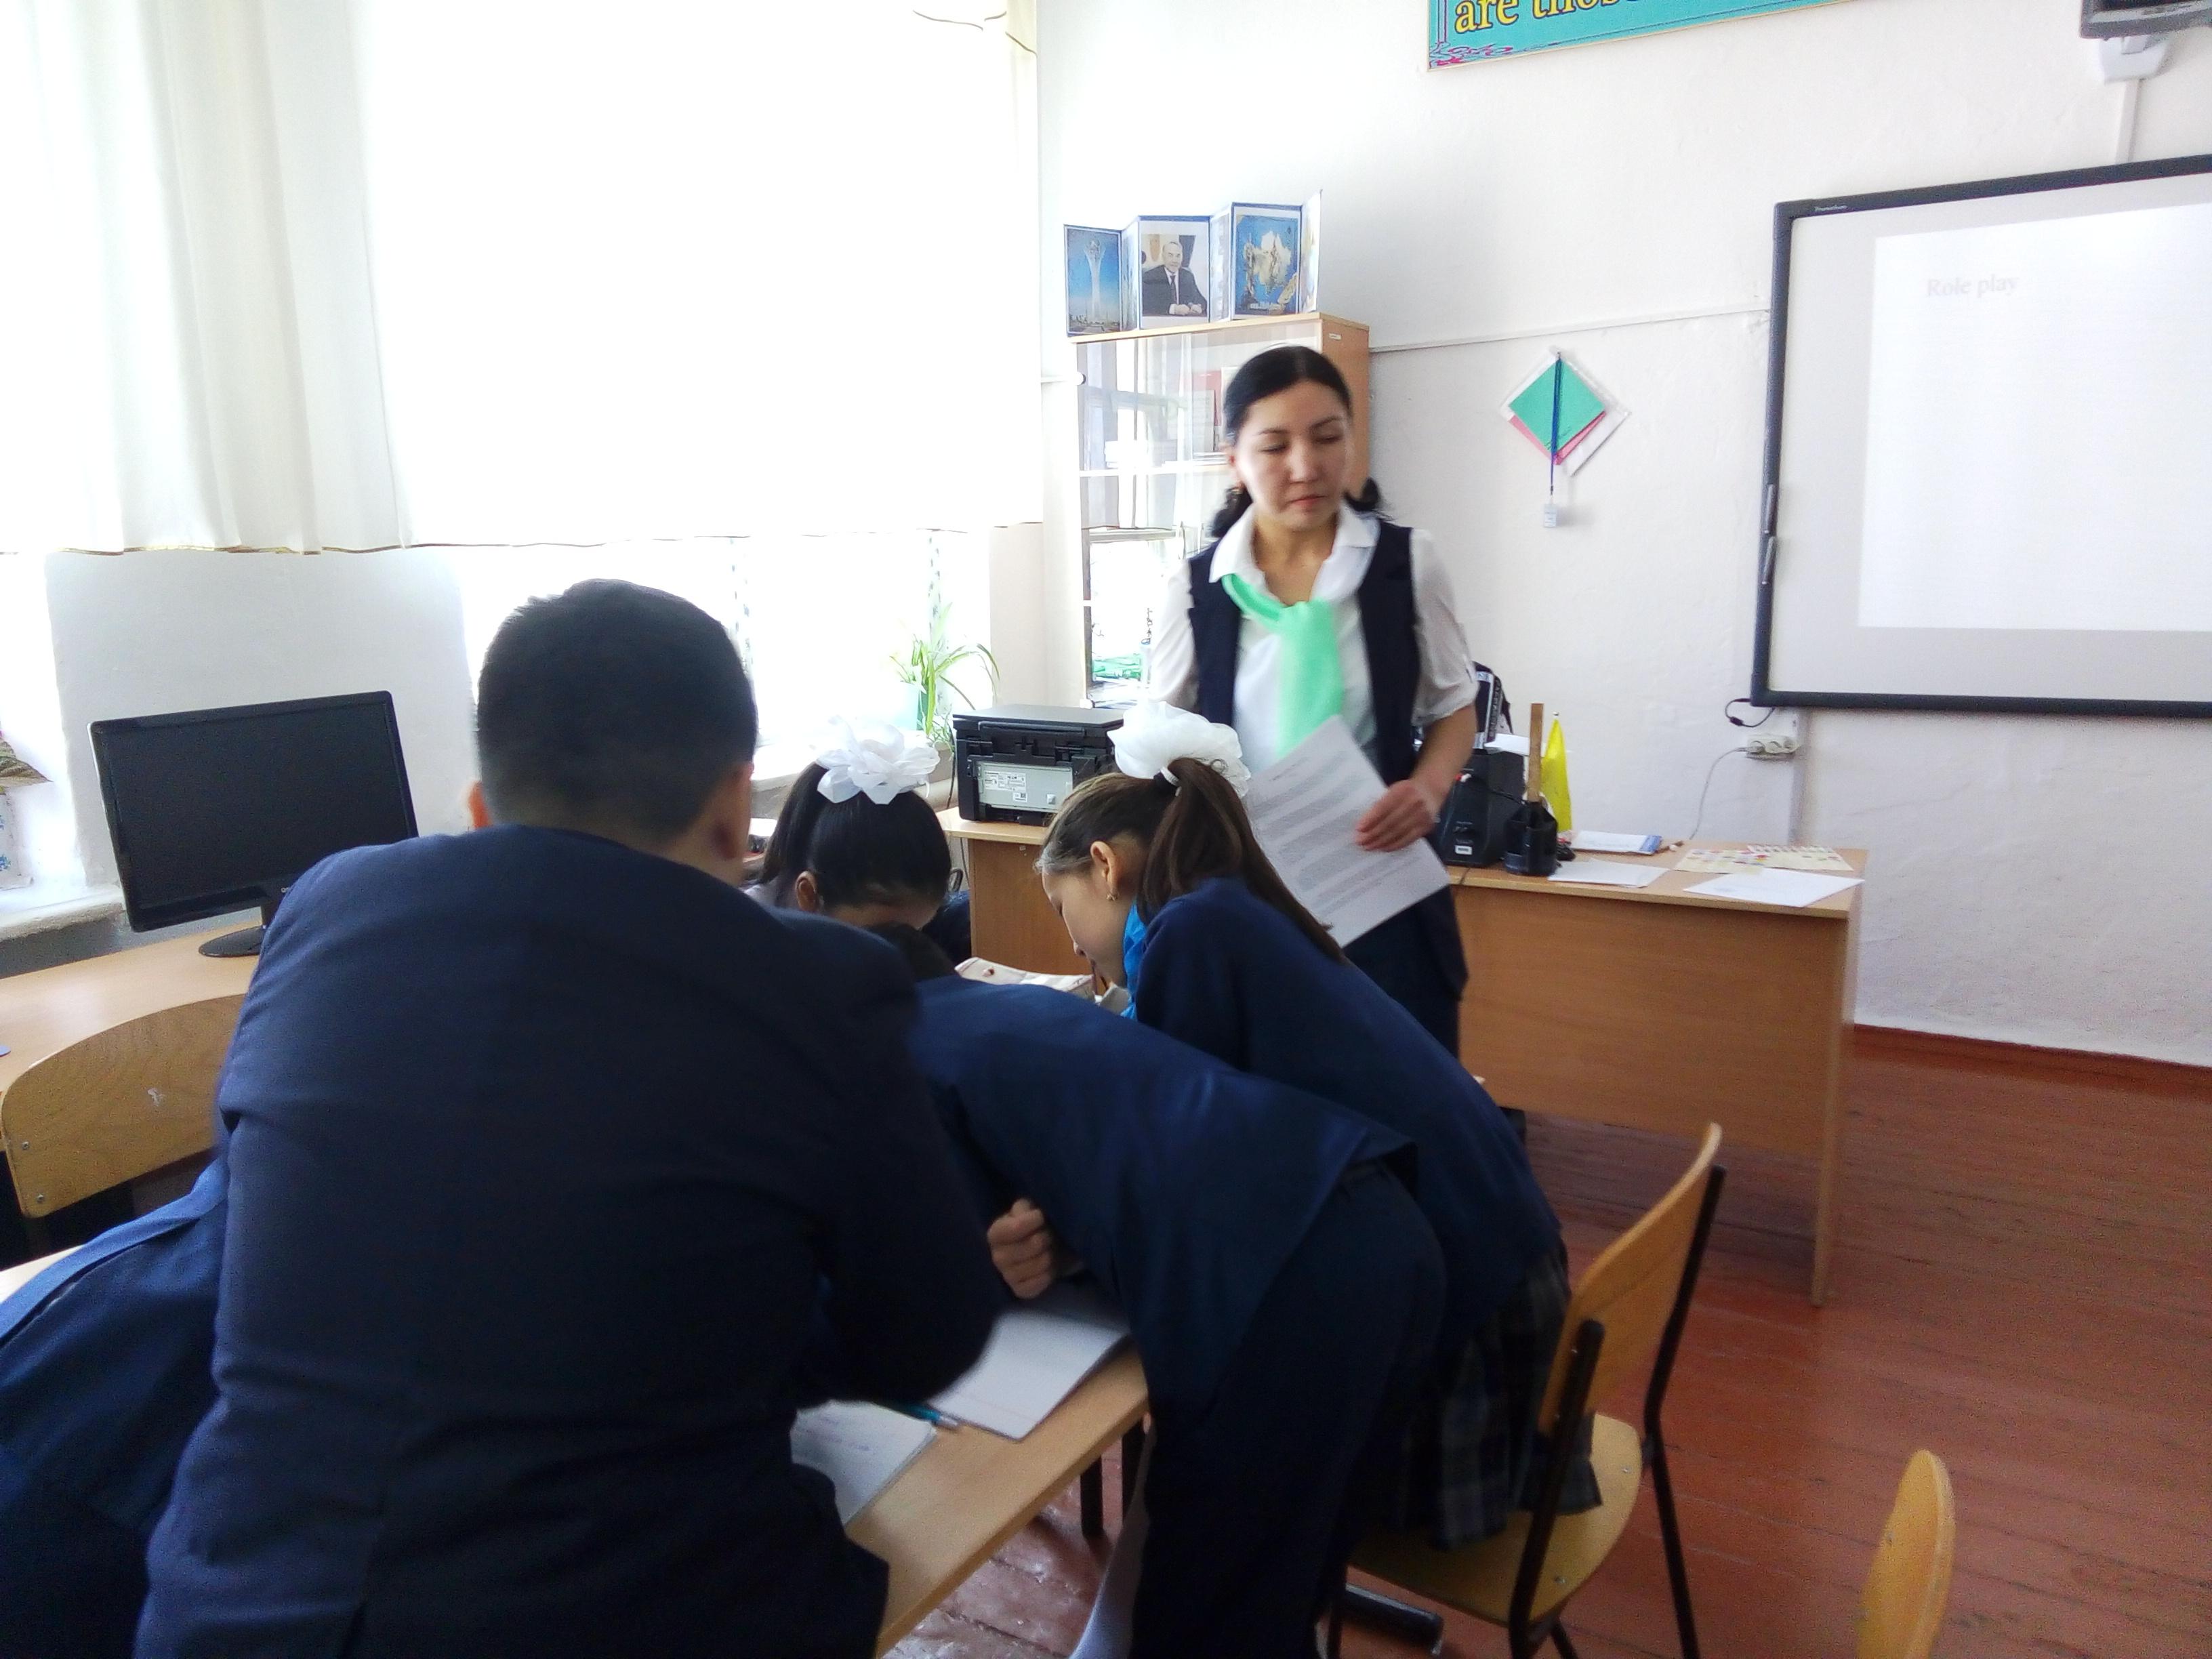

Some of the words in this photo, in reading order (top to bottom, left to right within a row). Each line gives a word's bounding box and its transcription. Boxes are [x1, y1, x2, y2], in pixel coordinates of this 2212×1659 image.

[1454, 0, 1519, 33] are
[1927, 276, 1971, 297] Role
[1977, 273, 2020, 299] play
